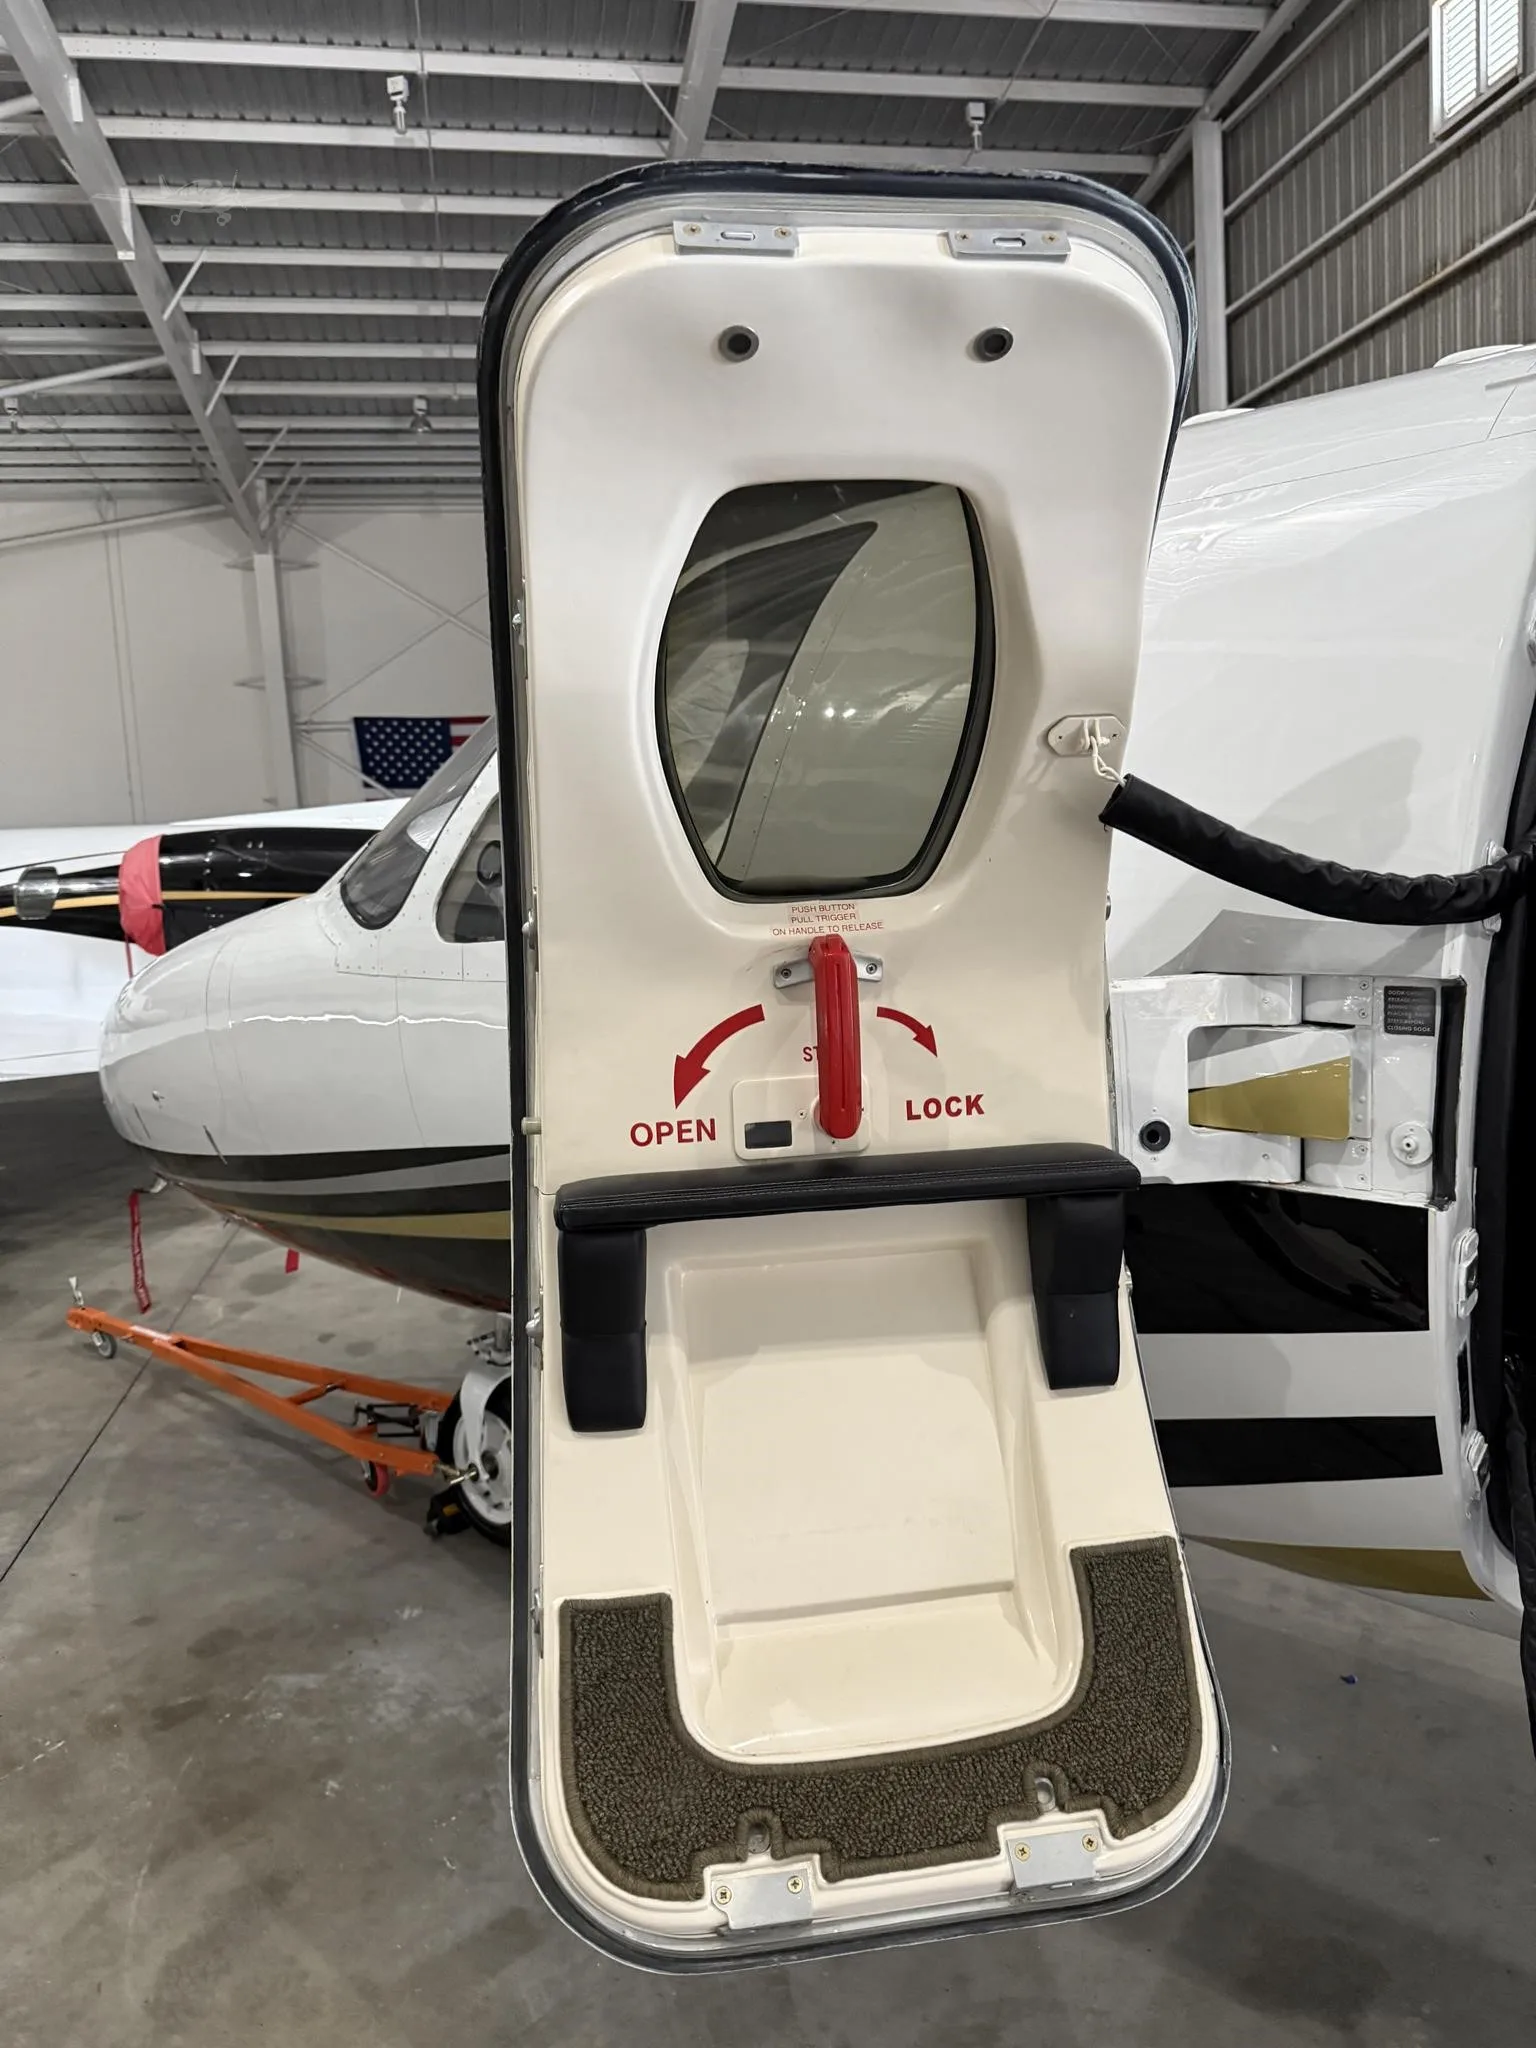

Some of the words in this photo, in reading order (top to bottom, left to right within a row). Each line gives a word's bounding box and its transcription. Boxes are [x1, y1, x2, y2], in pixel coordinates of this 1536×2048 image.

[791, 905, 817, 914] PUSH
[819, 903, 855, 912] BUTTON
[791, 915, 814, 924] PULL
[816, 913, 857, 922] TRIGGER
[772, 928, 786, 936] ON
[788, 925, 825, 935] HANDLE
[827, 924, 840, 933] TO
[841, 921, 884, 932] RELEASE
[906, 1094, 985, 1121] LOCK
[630, 1118, 716, 1147] OPEN
